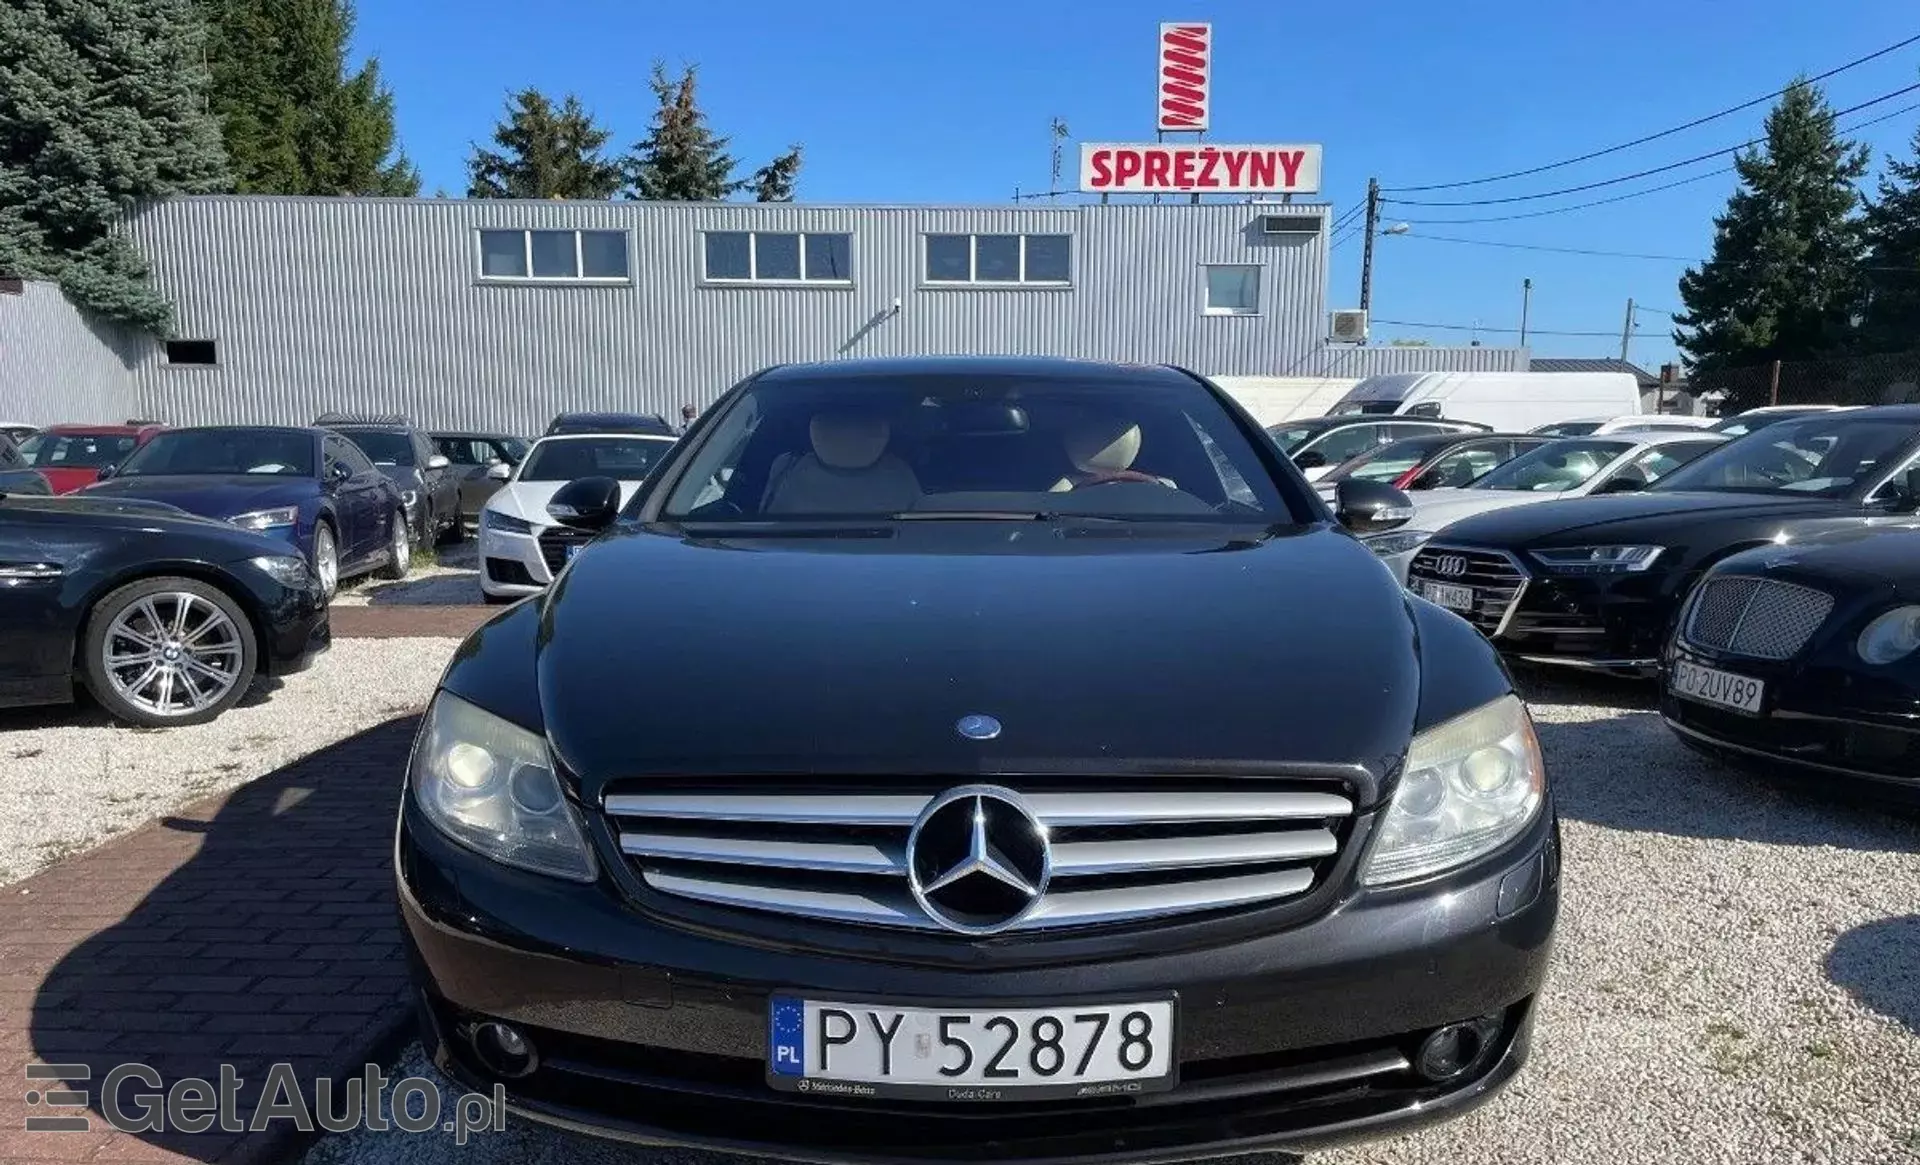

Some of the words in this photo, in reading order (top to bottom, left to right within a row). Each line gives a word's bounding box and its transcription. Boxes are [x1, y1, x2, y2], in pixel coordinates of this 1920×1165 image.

[1091, 147, 1305, 191] SPRĘŻYNY
[1678, 665, 1697, 691] PO
[1699, 671, 1757, 706] 2UV89
[776, 1046, 800, 1064] PL
[819, 1008, 905, 1075] PY
[938, 1011, 1154, 1078] 52878
